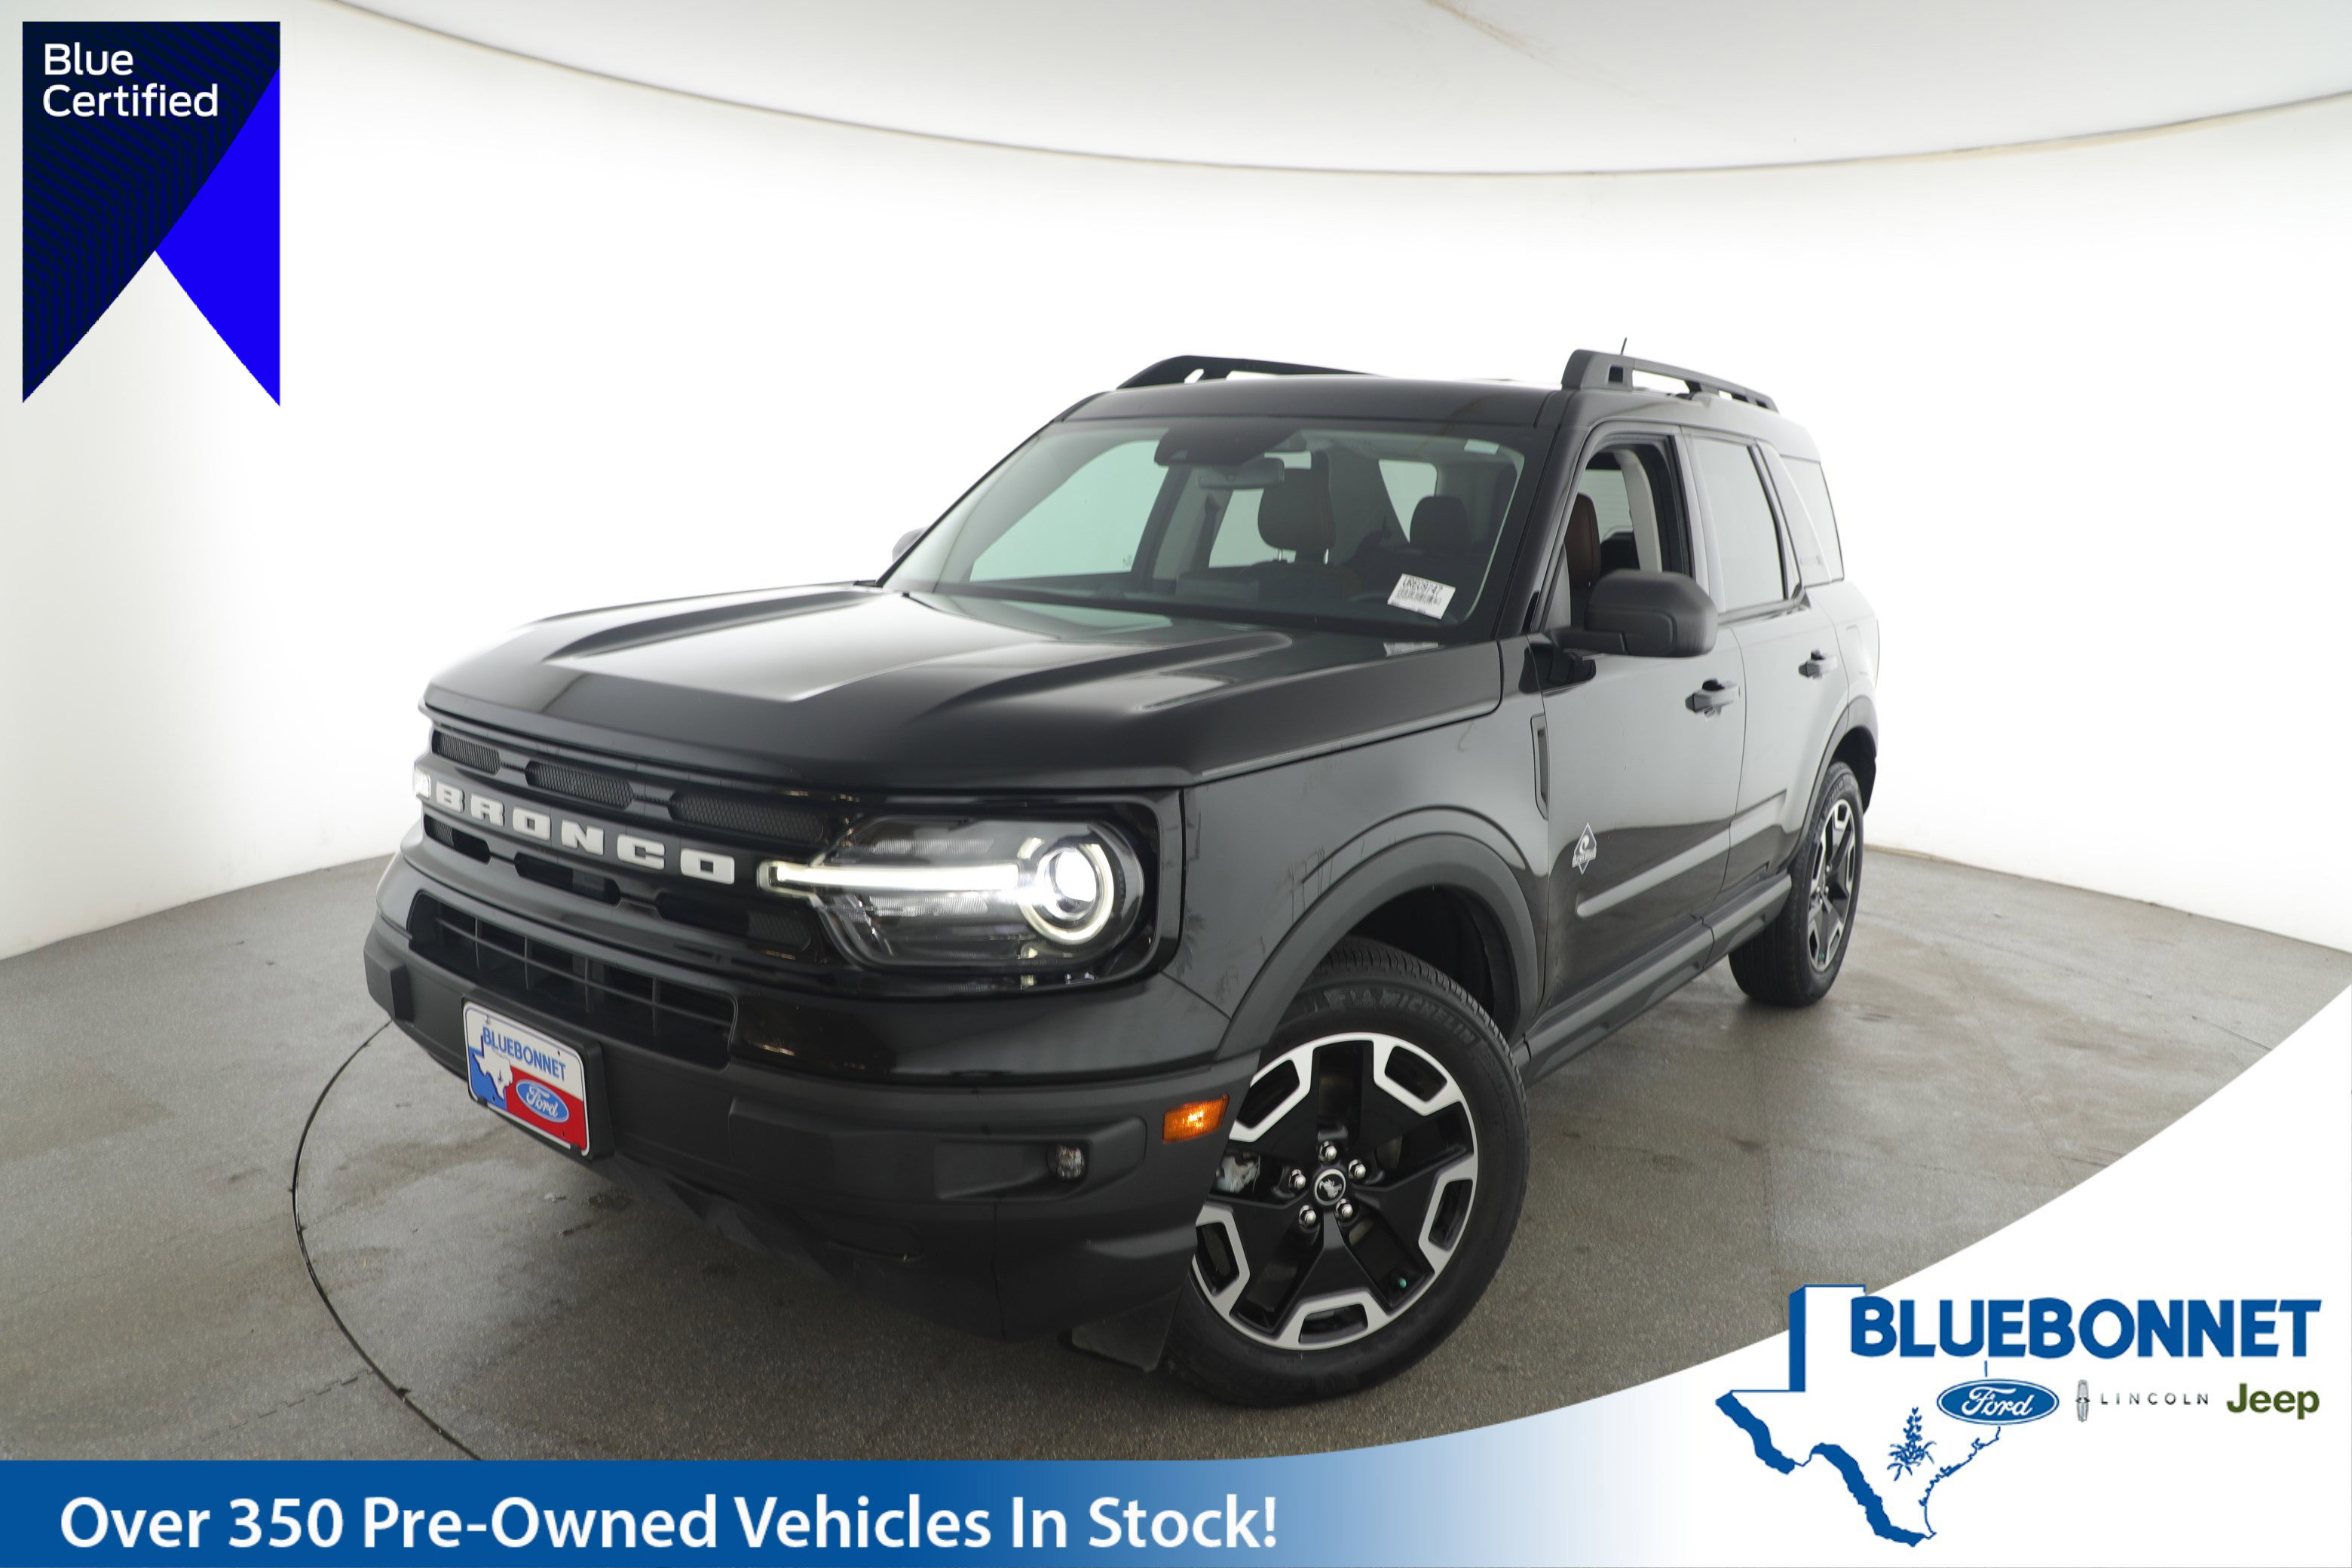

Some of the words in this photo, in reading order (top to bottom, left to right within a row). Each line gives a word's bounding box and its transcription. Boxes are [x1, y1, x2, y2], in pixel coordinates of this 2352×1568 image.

[436, 782, 735, 885] BRONCO
[482, 1027, 566, 1082] BLUEBONNET
[526, 1084, 559, 1117] Ford
